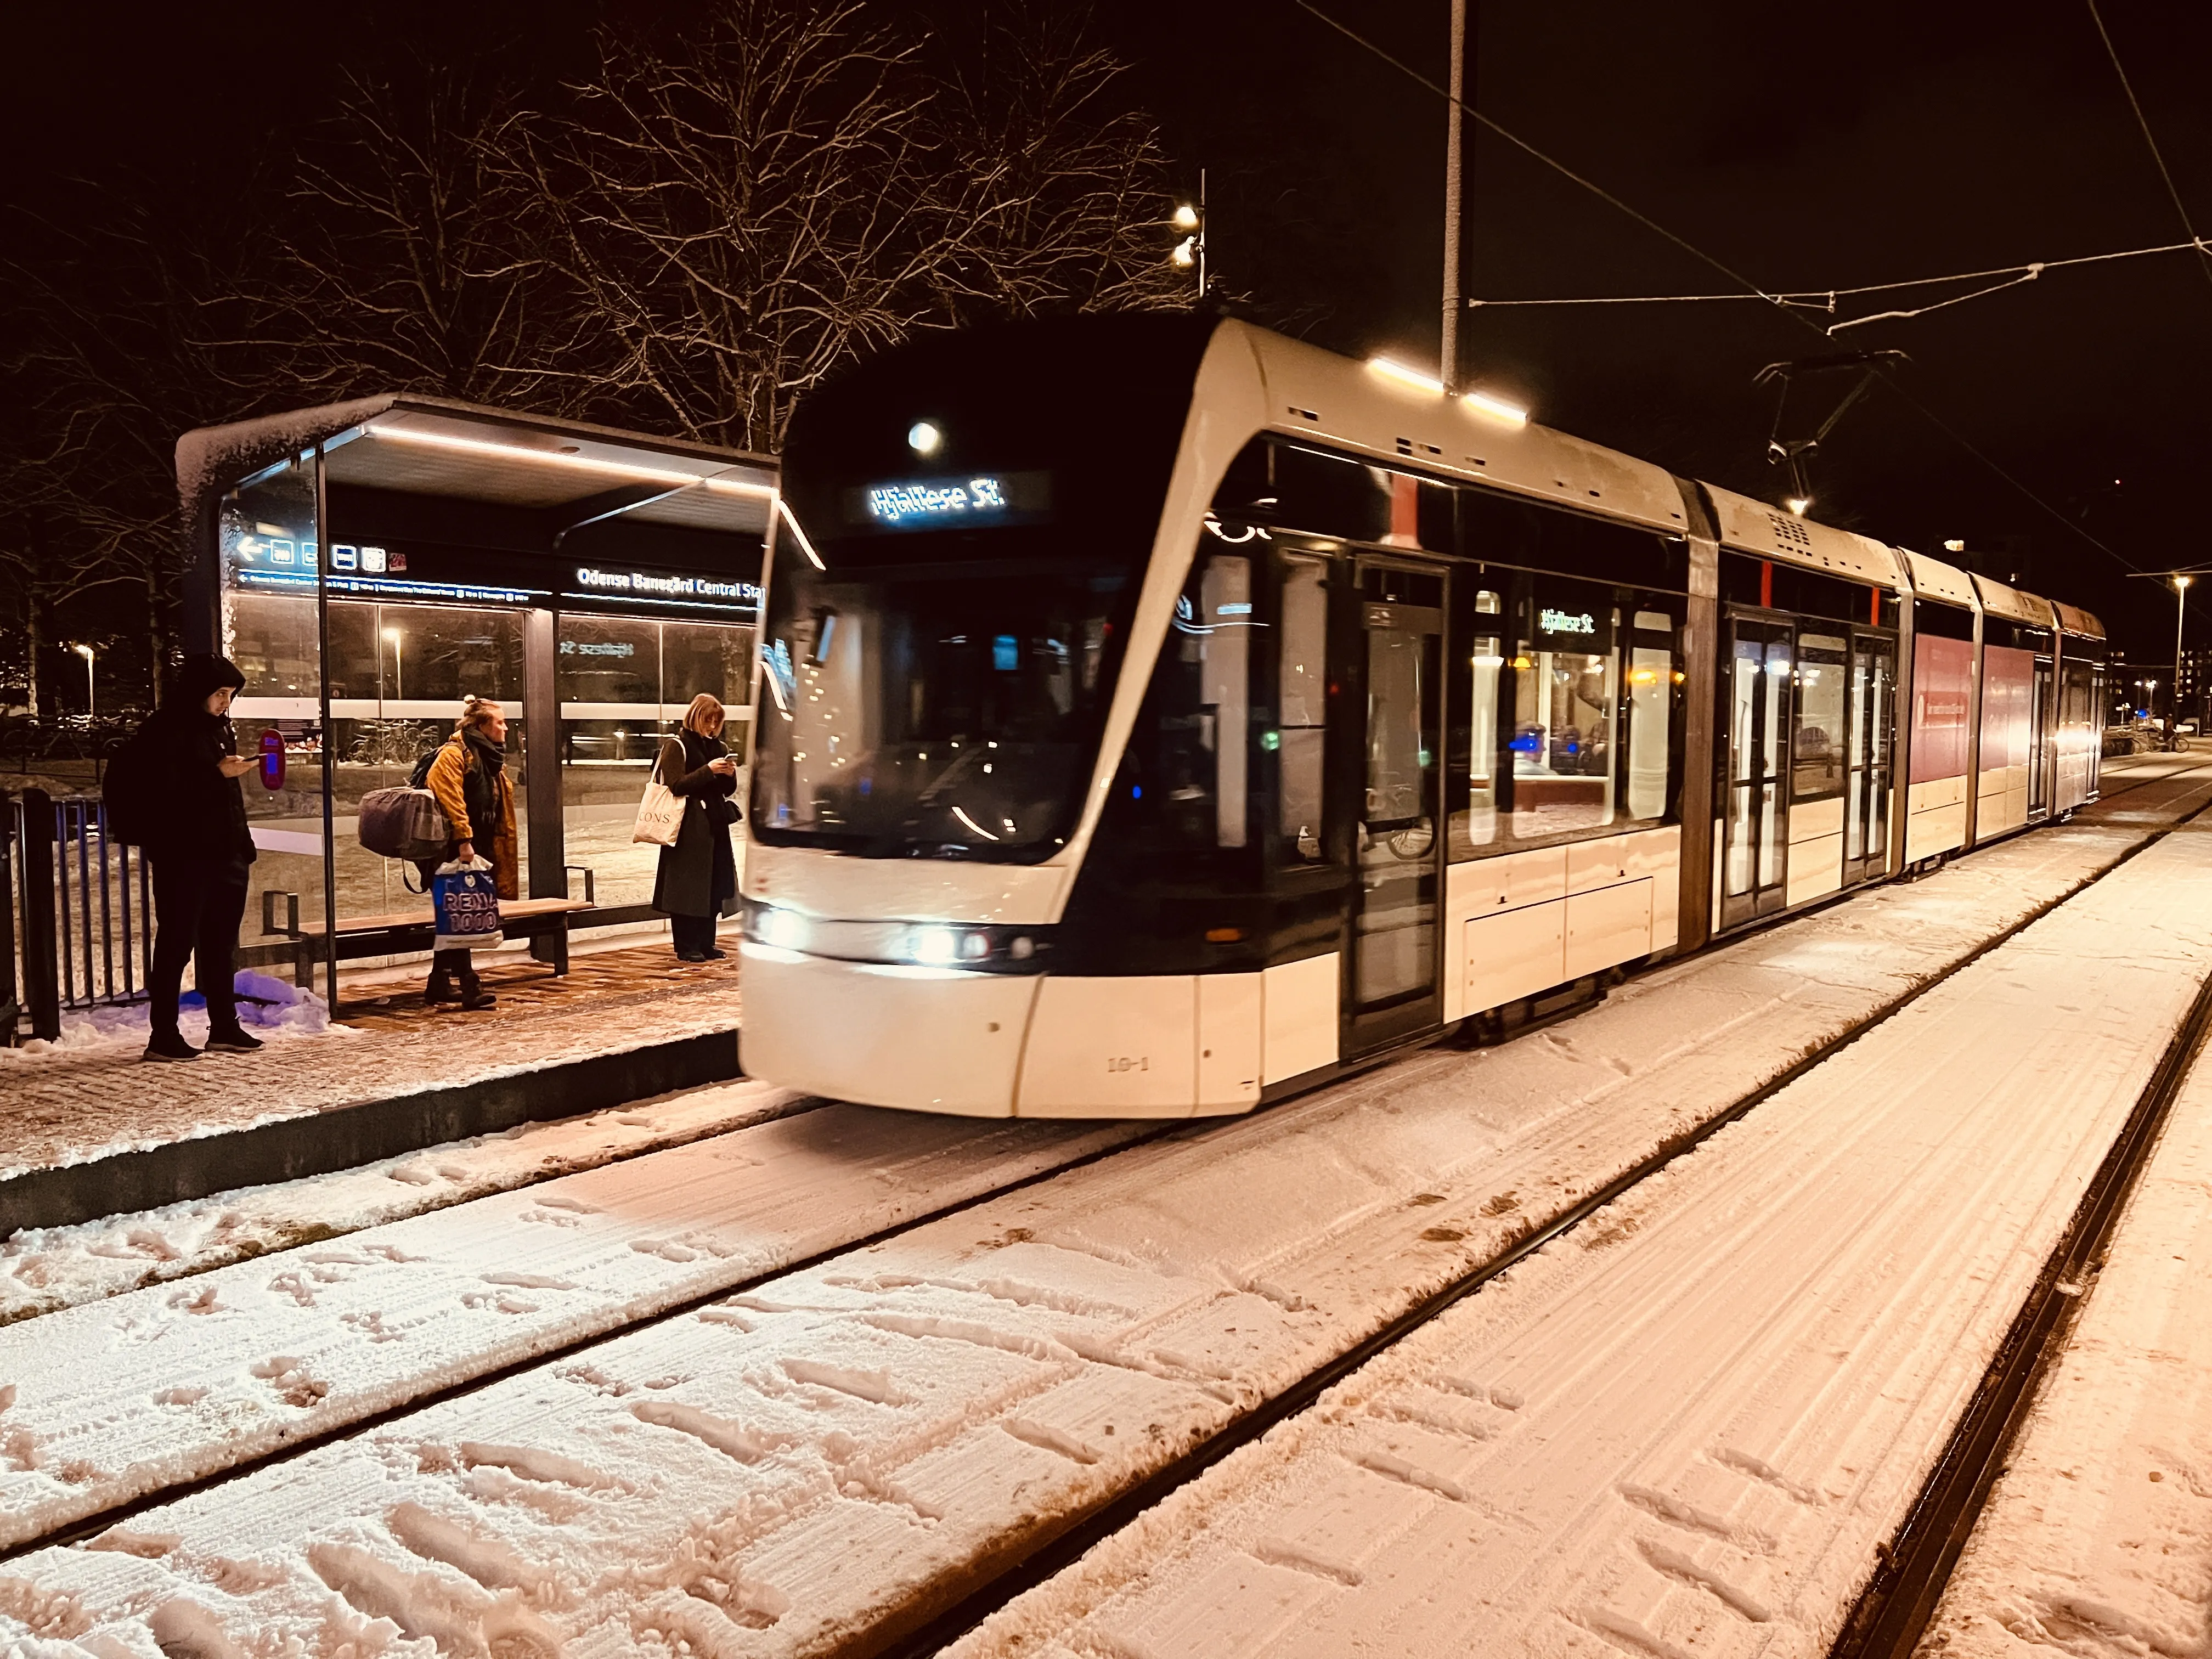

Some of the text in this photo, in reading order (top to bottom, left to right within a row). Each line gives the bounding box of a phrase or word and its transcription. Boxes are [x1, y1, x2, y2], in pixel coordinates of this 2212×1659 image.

[871, 486, 968, 521] Hjallese
[577, 567, 630, 589] Odense
[632, 573, 694, 594] Banegård
[696, 579, 741, 597] Central
[449, 911, 497, 932] 1000
